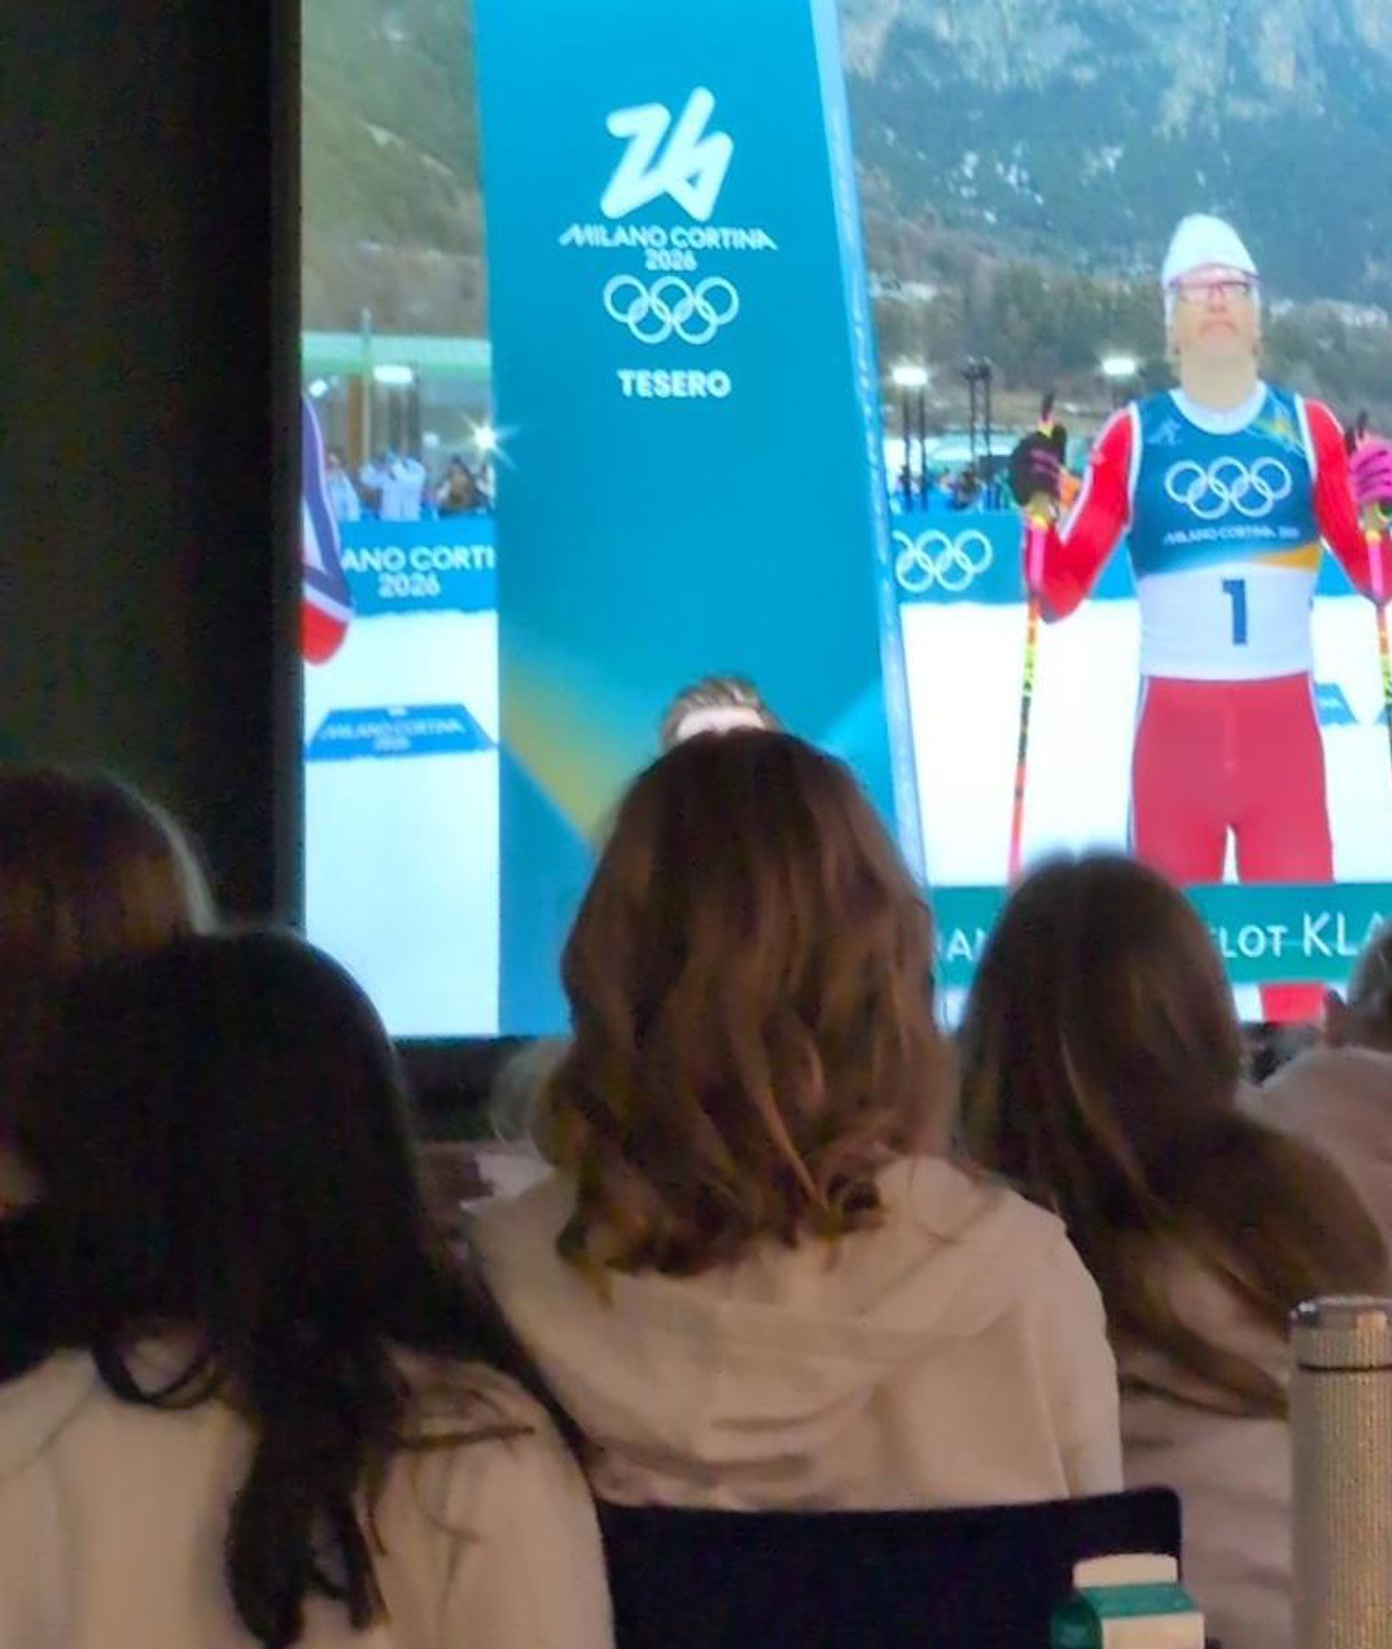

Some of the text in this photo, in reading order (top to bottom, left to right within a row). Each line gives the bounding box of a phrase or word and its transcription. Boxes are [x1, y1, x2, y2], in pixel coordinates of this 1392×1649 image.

[558, 223, 779, 251] MILANO CORTINA
[645, 247, 698, 271] 2026
[615, 368, 732, 398] TESERO
[341, 545, 495, 573] ANO CORTI
[377, 571, 442, 598] 2026
[1222, 579, 1247, 644] 1
[1210, 924, 1288, 959] LOT
